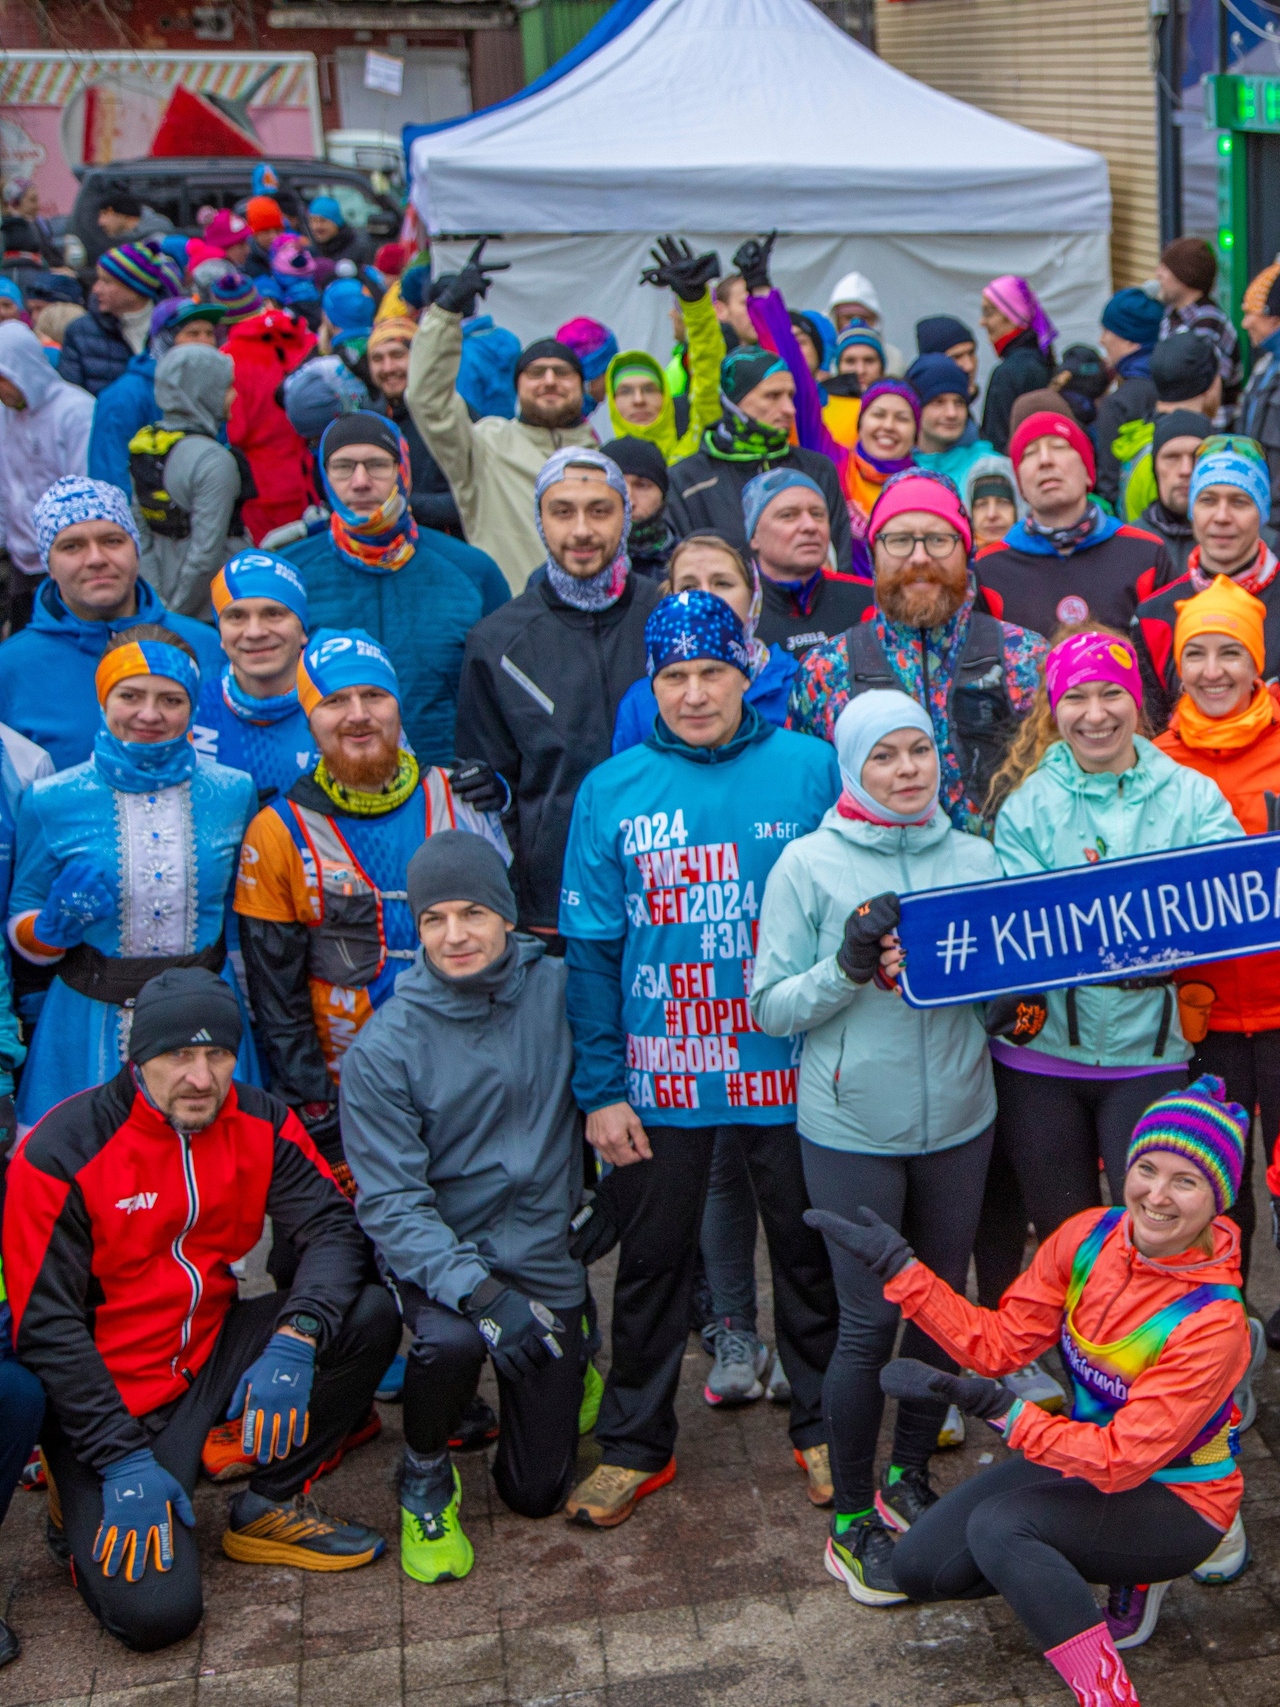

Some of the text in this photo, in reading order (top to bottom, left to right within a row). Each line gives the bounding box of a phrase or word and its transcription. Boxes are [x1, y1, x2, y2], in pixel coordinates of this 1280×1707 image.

[619, 808, 688, 856] 2024
[701, 920, 760, 960] #ЗА
[626, 1071, 700, 1109] ЗАБЕГ
